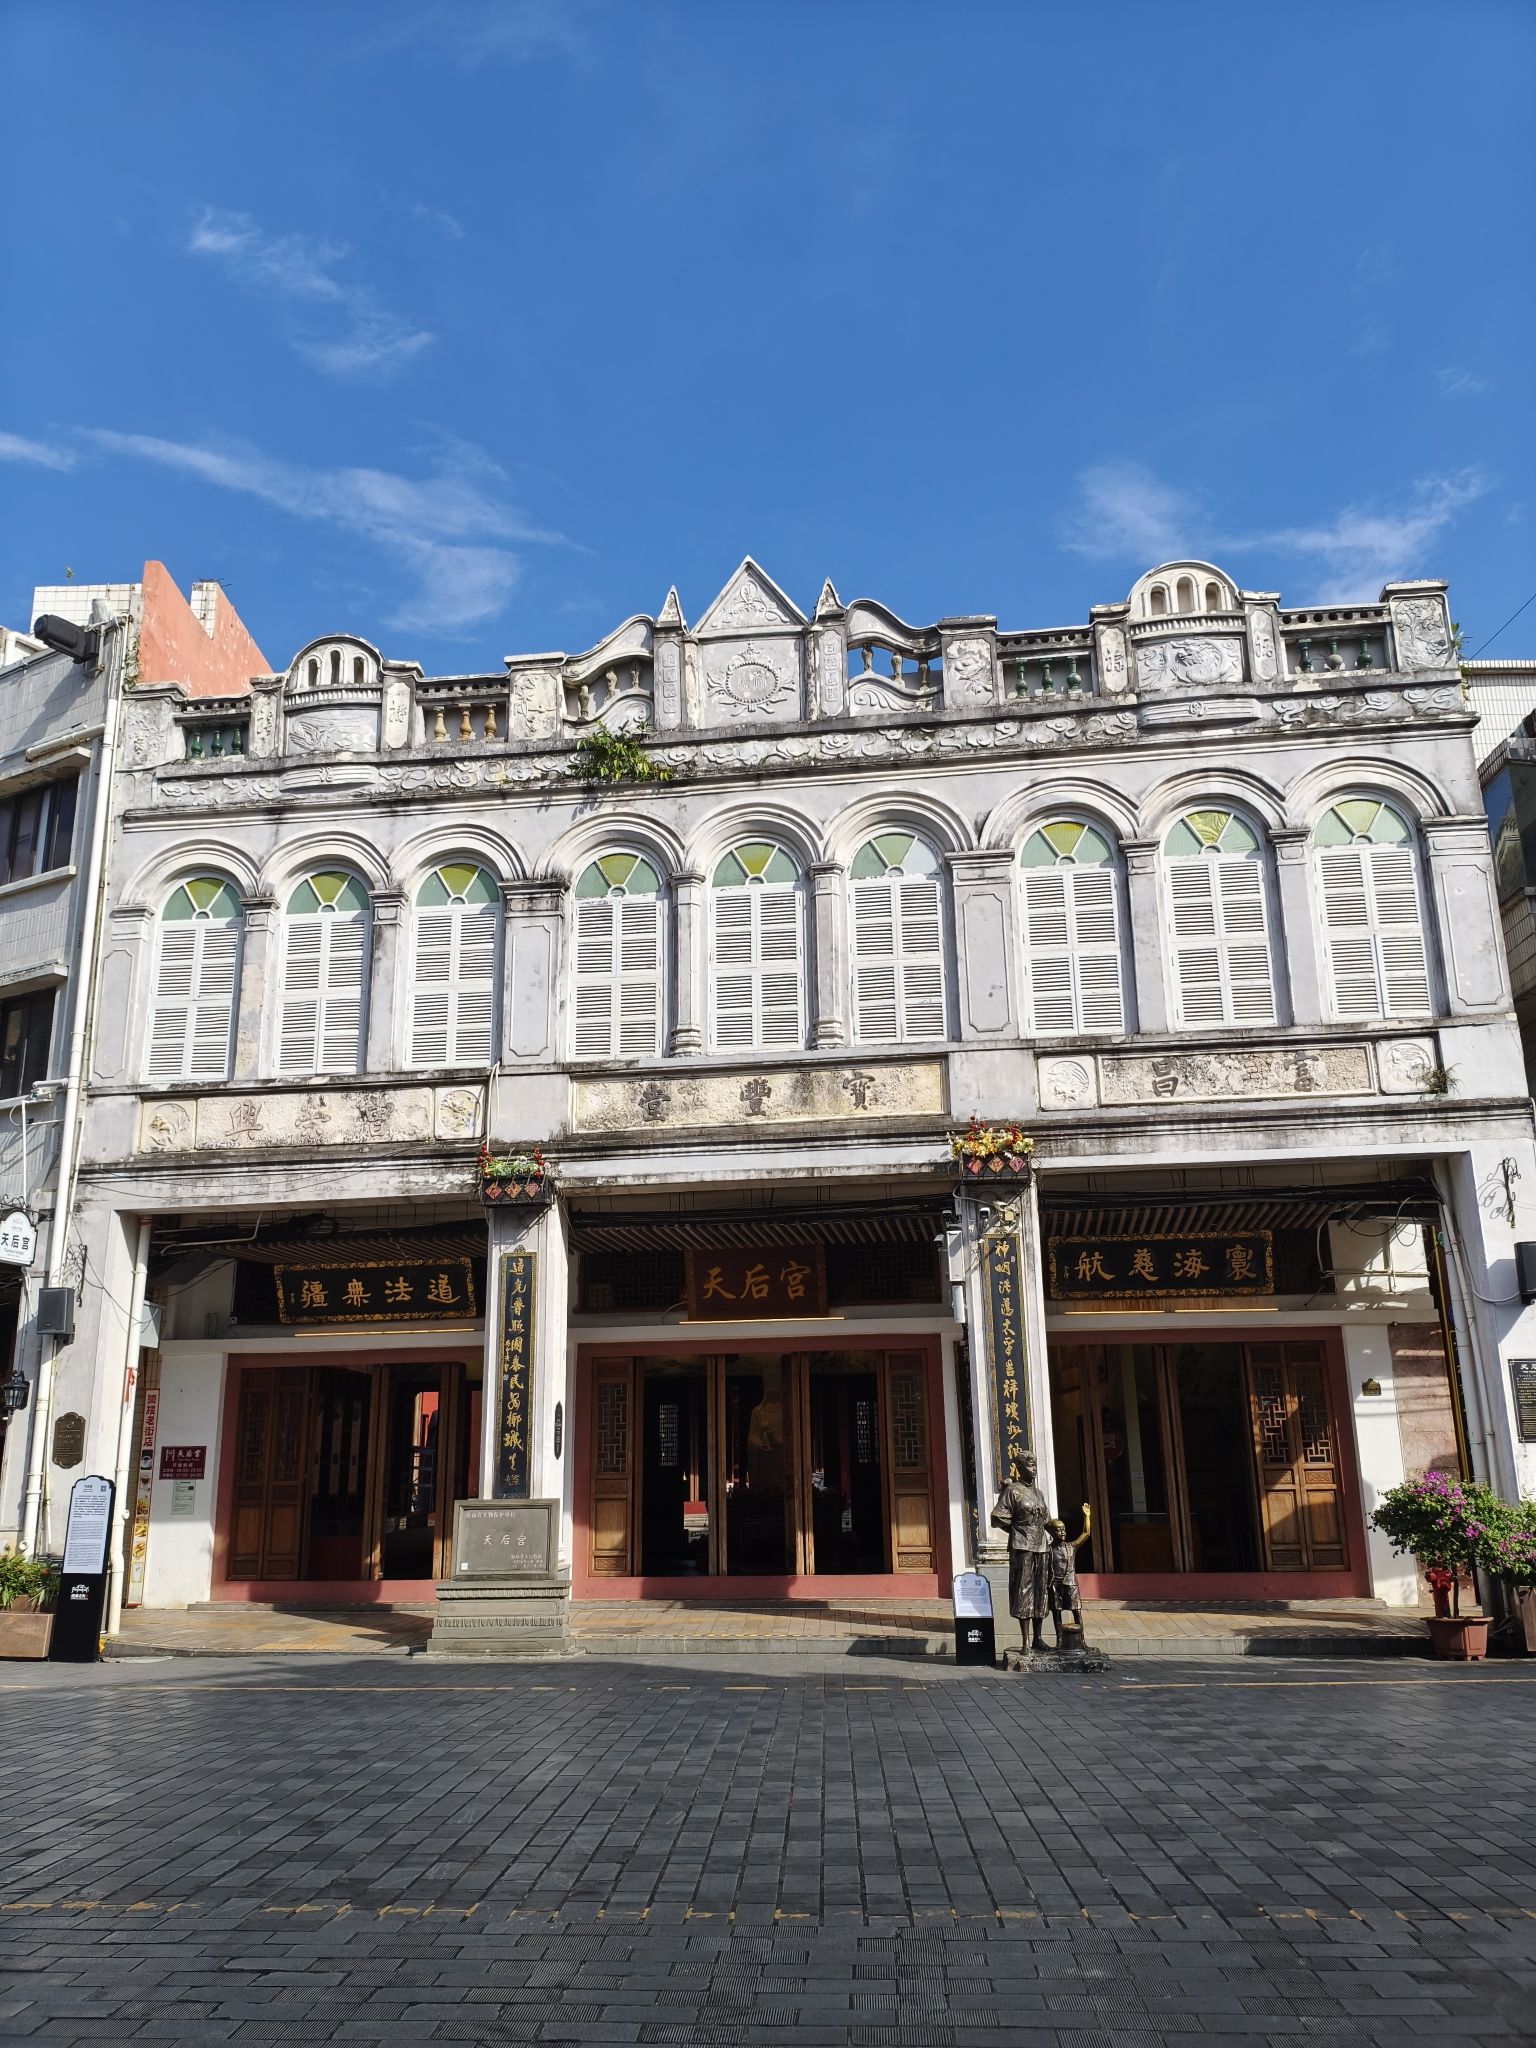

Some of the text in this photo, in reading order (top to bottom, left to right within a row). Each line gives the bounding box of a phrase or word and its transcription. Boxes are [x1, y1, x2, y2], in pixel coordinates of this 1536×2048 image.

[1, 1232, 30, 1250] 天后宫
[701, 1260, 811, 1299] 天后宫
[483, 1533, 527, 1546] 天后宫
